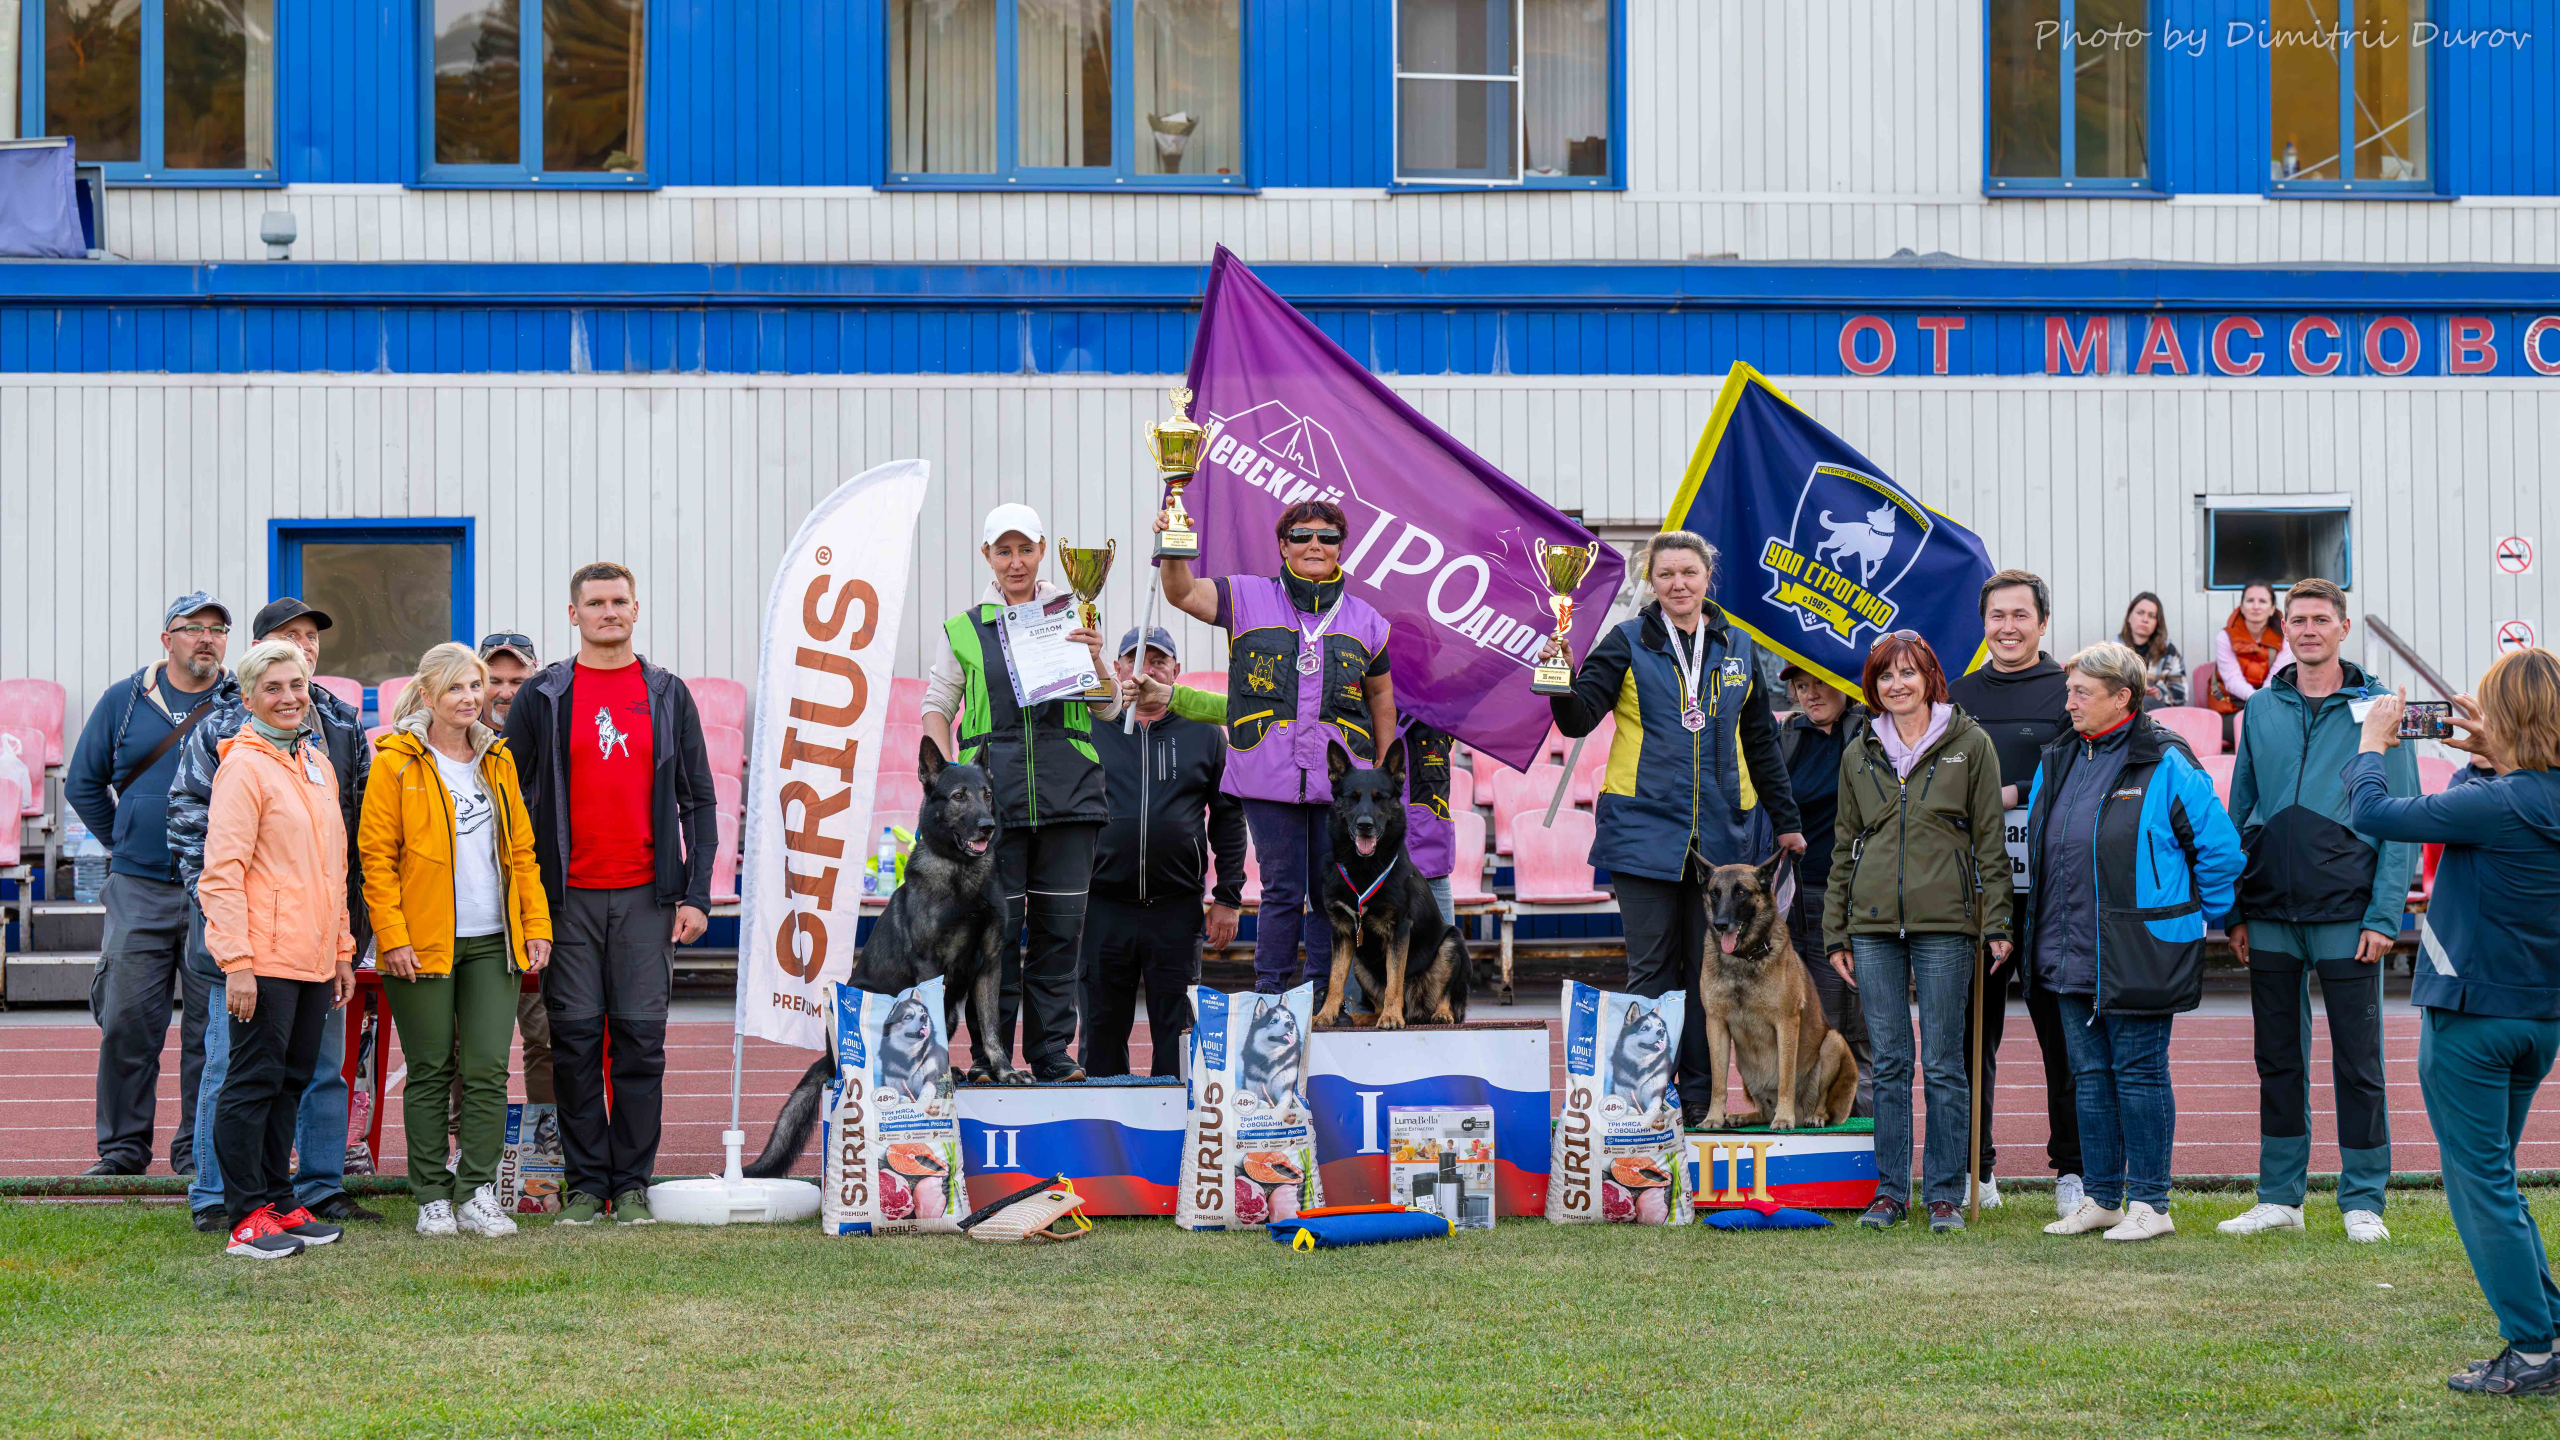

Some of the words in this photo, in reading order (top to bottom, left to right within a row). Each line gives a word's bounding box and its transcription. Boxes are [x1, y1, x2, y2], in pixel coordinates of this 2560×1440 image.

[1838, 314, 1966, 376] ОТ
[1765, 542, 1805, 577] УДП
[1802, 560, 1894, 628] СТРОГИНО
[1808, 595, 1828, 613] 1987
[1029, 624, 1063, 637] ДИПЛОМ
[1695, 714, 1703, 724] 3
[842, 1038, 862, 1051] ADULT
[1202, 1040, 1224, 1052] ADULT
[1570, 1045, 1592, 1058] ADULT
[876, 1095, 896, 1104] 48%
[1237, 1098, 1255, 1106] 48%
[895, 1107, 915, 1115] МЯСА
[1604, 1103, 1624, 1112] 48%
[887, 1112, 925, 1122] ОВОЩАМИ
[1355, 1091, 1385, 1154] I
[1246, 1120, 1283, 1128] ОВОЩАМИ
[841, 1077, 868, 1206] SIRIUS
[1195, 1082, 1224, 1211] SIRIUS
[982, 1129, 1021, 1168] II
[1562, 1087, 1593, 1212] SIRIUS
[1691, 1141, 1775, 1202] III
[500, 1149, 518, 1208] SIRIUS
